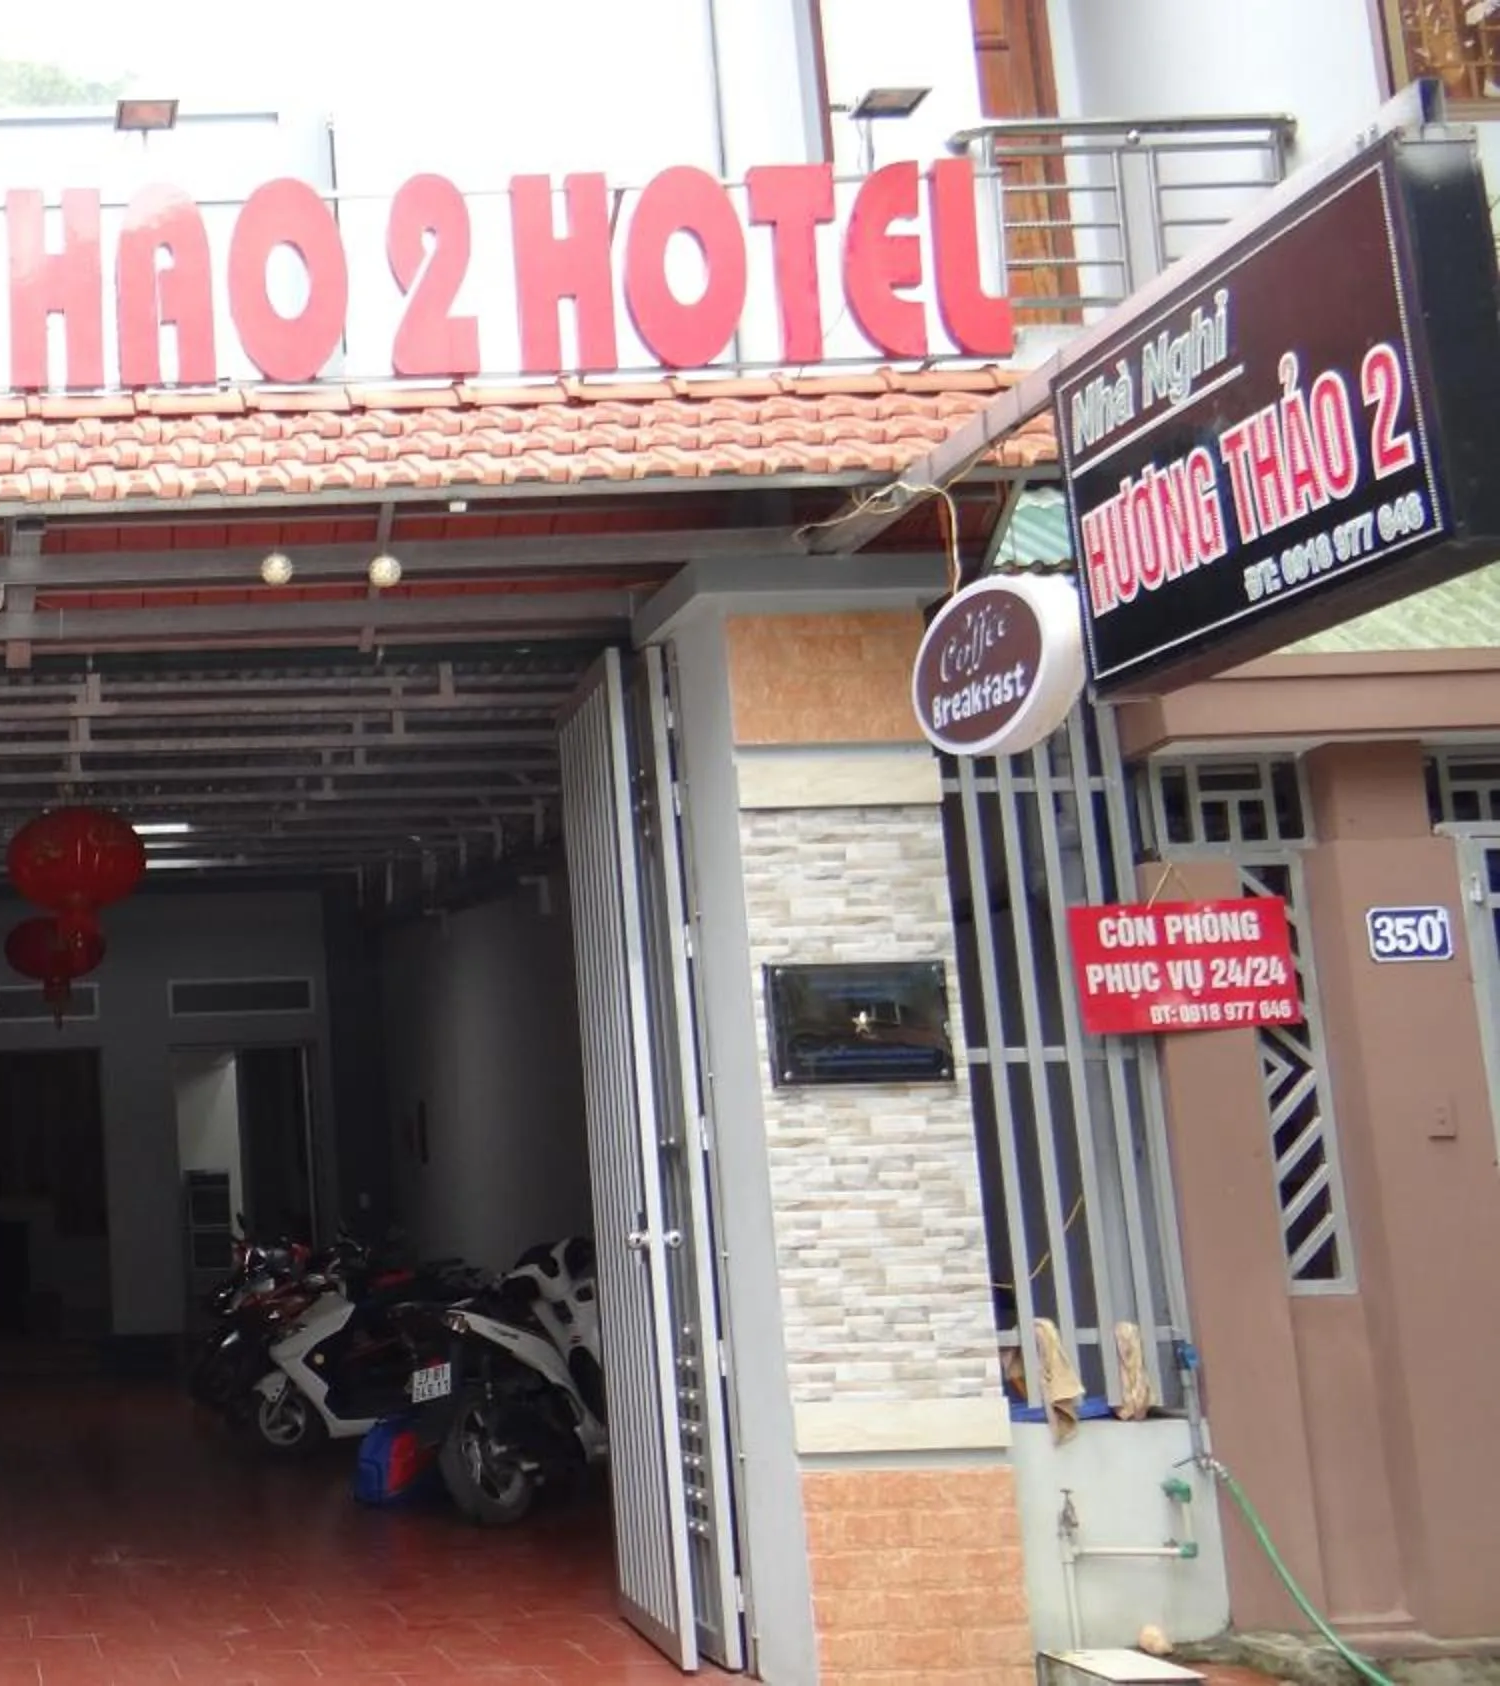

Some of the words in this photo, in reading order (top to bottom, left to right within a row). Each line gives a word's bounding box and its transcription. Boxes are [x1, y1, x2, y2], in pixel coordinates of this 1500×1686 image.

[386, 172, 481, 380] 2
[508, 158, 1014, 374] HOTEL
[1071, 359, 1136, 456] Nhà
[1141, 289, 1229, 409] Nghỉ
[1081, 446, 1229, 619] HƯƠNG
[1219, 352, 1359, 545] THẢO
[1361, 343, 1416, 481] 2
[931, 661, 1028, 729] Breakfast
[1097, 910, 1158, 949] CÒN
[1163, 907, 1261, 945] PHÒNG
[1085, 962, 1162, 1000] PHỤC
[1166, 959, 1205, 997] VỤ
[1209, 956, 1288, 989] 24/24
[1223, 1001, 1255, 1021] 977
